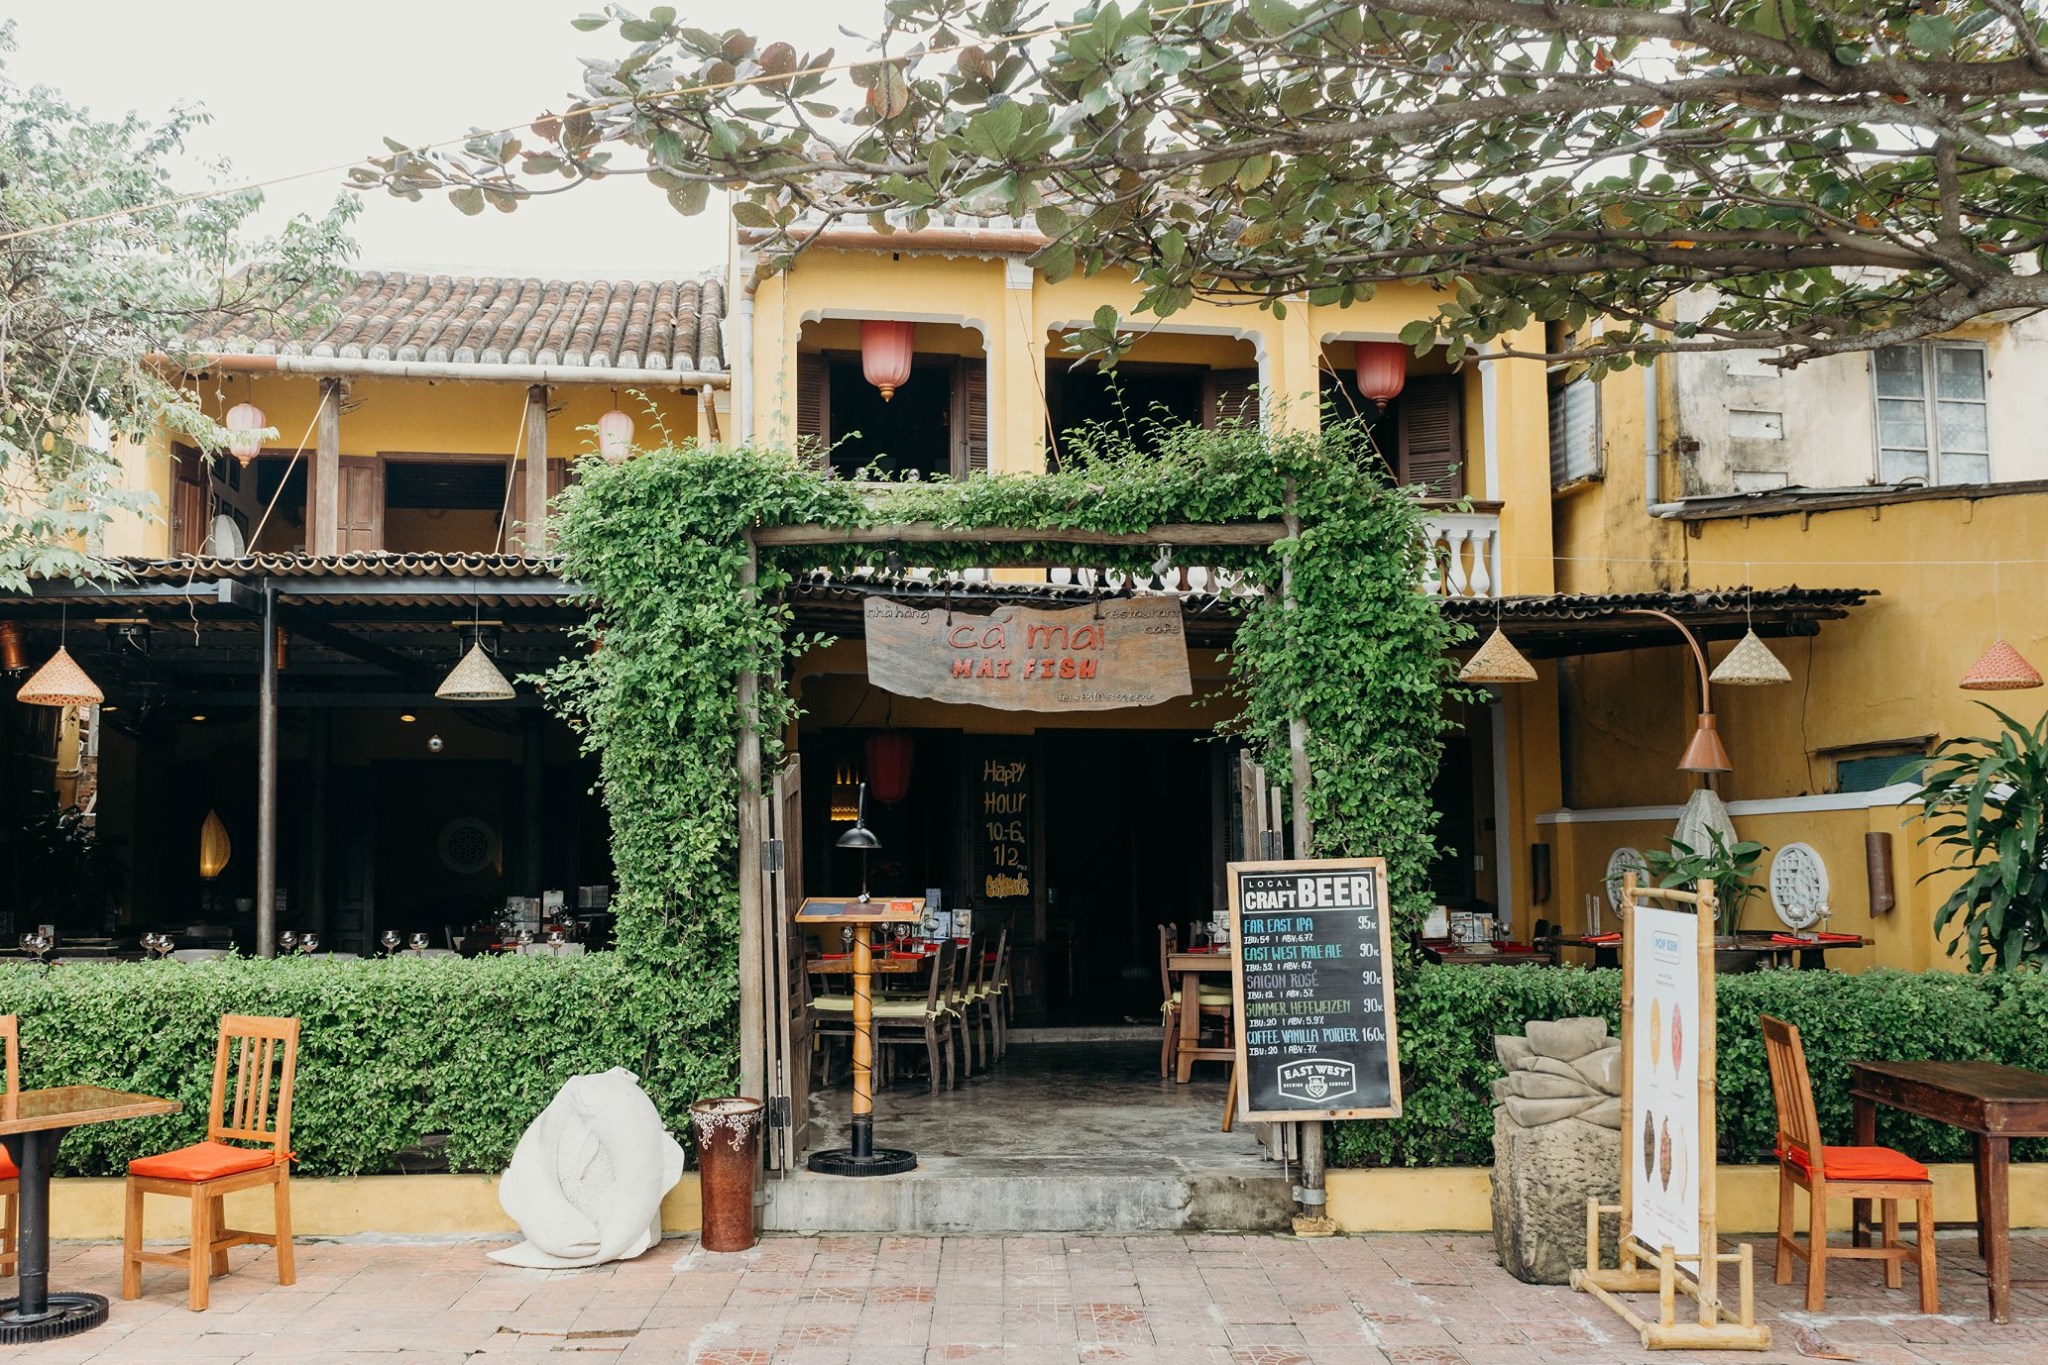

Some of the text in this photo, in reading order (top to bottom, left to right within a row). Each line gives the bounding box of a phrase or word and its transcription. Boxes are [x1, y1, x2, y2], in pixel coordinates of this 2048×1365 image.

[1103, 607, 1180, 619] restaurant
[948, 613, 1105, 650] cá mai
[952, 658, 1098, 679] MAI FISH
[983, 760, 1026, 787] Happy
[1245, 876, 1370, 910] CRAFT BEER
[1249, 880, 1291, 888] LOCAL
[1244, 919, 1265, 934] FAR
[1267, 918, 1293, 933] EAST
[1296, 917, 1313, 932] IPA
[1244, 946, 1269, 961] EAST
[1271, 945, 1299, 960] WEST
[1301, 944, 1324, 960] PALE
[1325, 943, 1344, 959] ALE
[1246, 974, 1287, 990] SAIGON
[1290, 969, 1319, 988] ROSÉ
[1246, 1001, 1289, 1017] SUMMER
[1290, 999, 1351, 1015] HEFEWEIZEN
[1246, 1029, 1280, 1045] COFFEE
[1281, 1028, 1319, 1044] VANILLA
[1322, 1027, 1360, 1043] PORTER
[1284, 1065, 1347, 1080] EAST WEST
